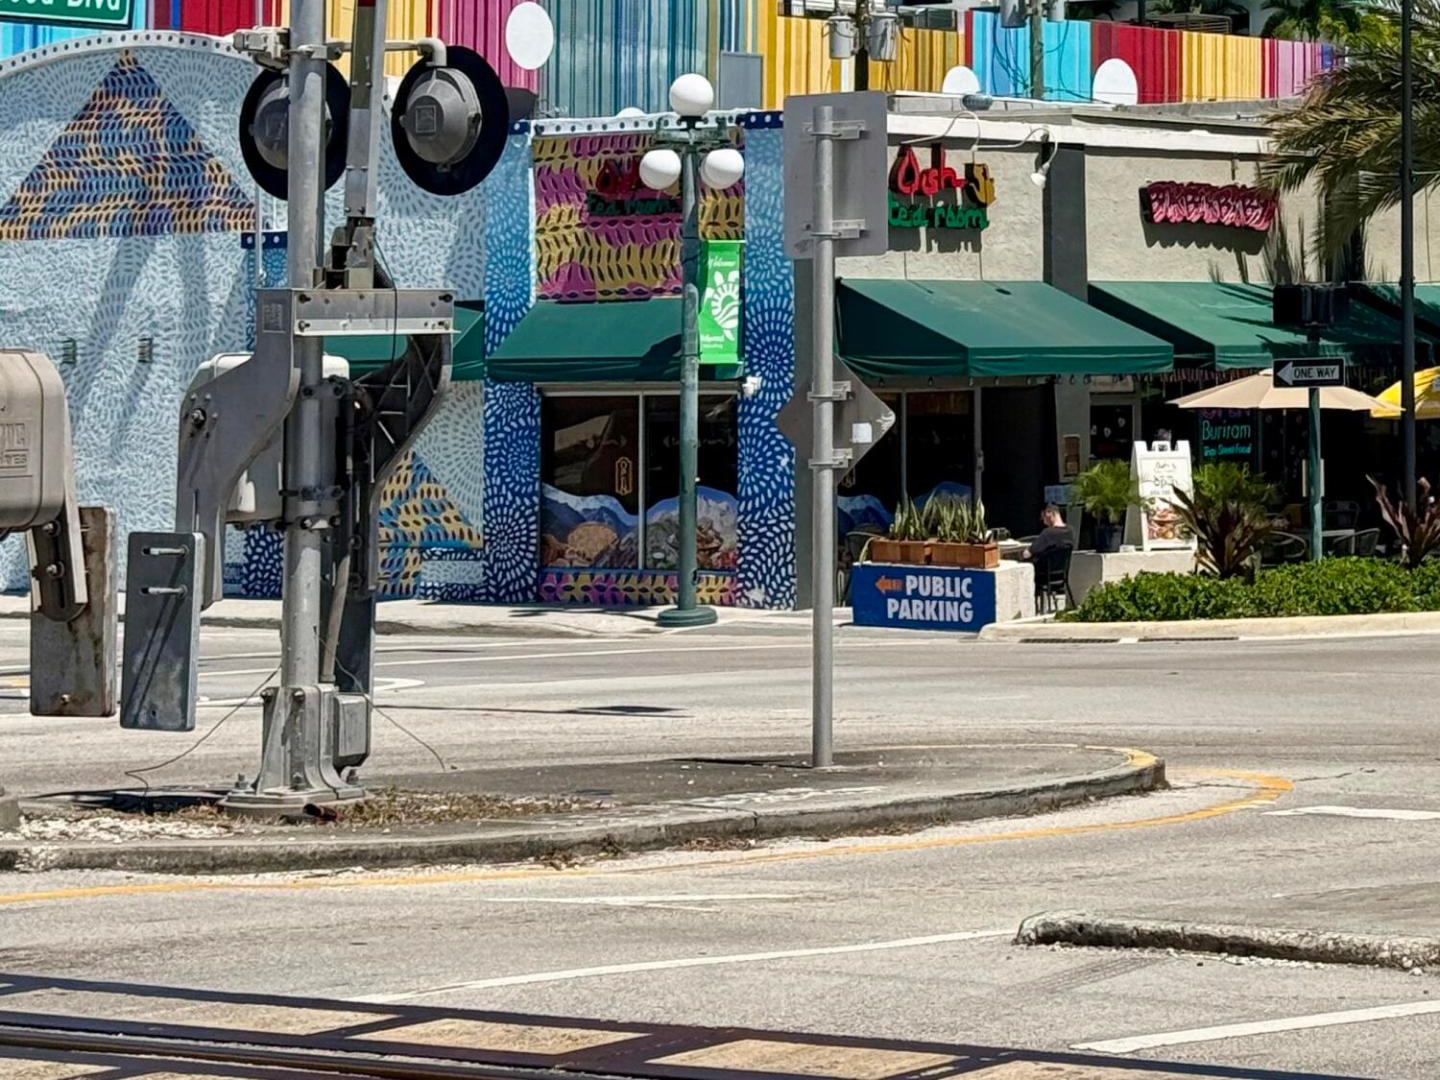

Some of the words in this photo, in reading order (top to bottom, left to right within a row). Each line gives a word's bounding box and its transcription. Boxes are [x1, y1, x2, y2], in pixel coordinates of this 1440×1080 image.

[1293, 367, 1314, 379] ONE
[1317, 366, 1337, 378] WAY
[905, 575, 973, 599] PUBLIC
[887, 598, 974, 623] PARKING
